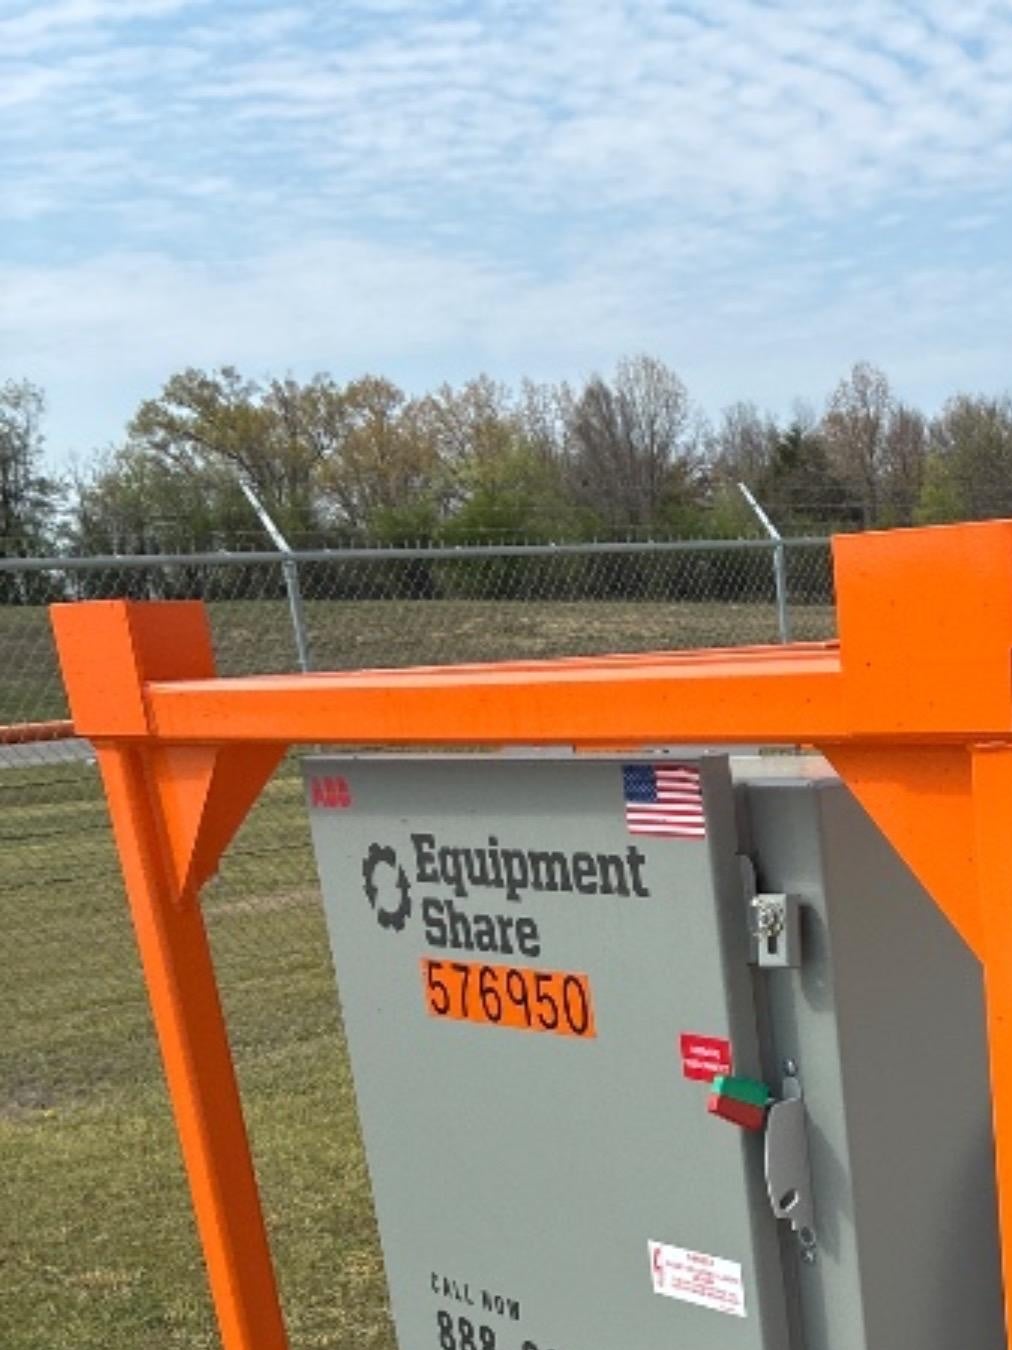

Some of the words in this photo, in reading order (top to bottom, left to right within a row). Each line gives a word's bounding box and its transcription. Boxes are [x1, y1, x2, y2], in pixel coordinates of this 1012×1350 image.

[411, 833, 650, 900] Equipment
[421, 899, 541, 957] Share
[426, 961, 589, 1036] 576950
[431, 1271, 474, 1305] CALL
[481, 1290, 520, 1321] NOW
